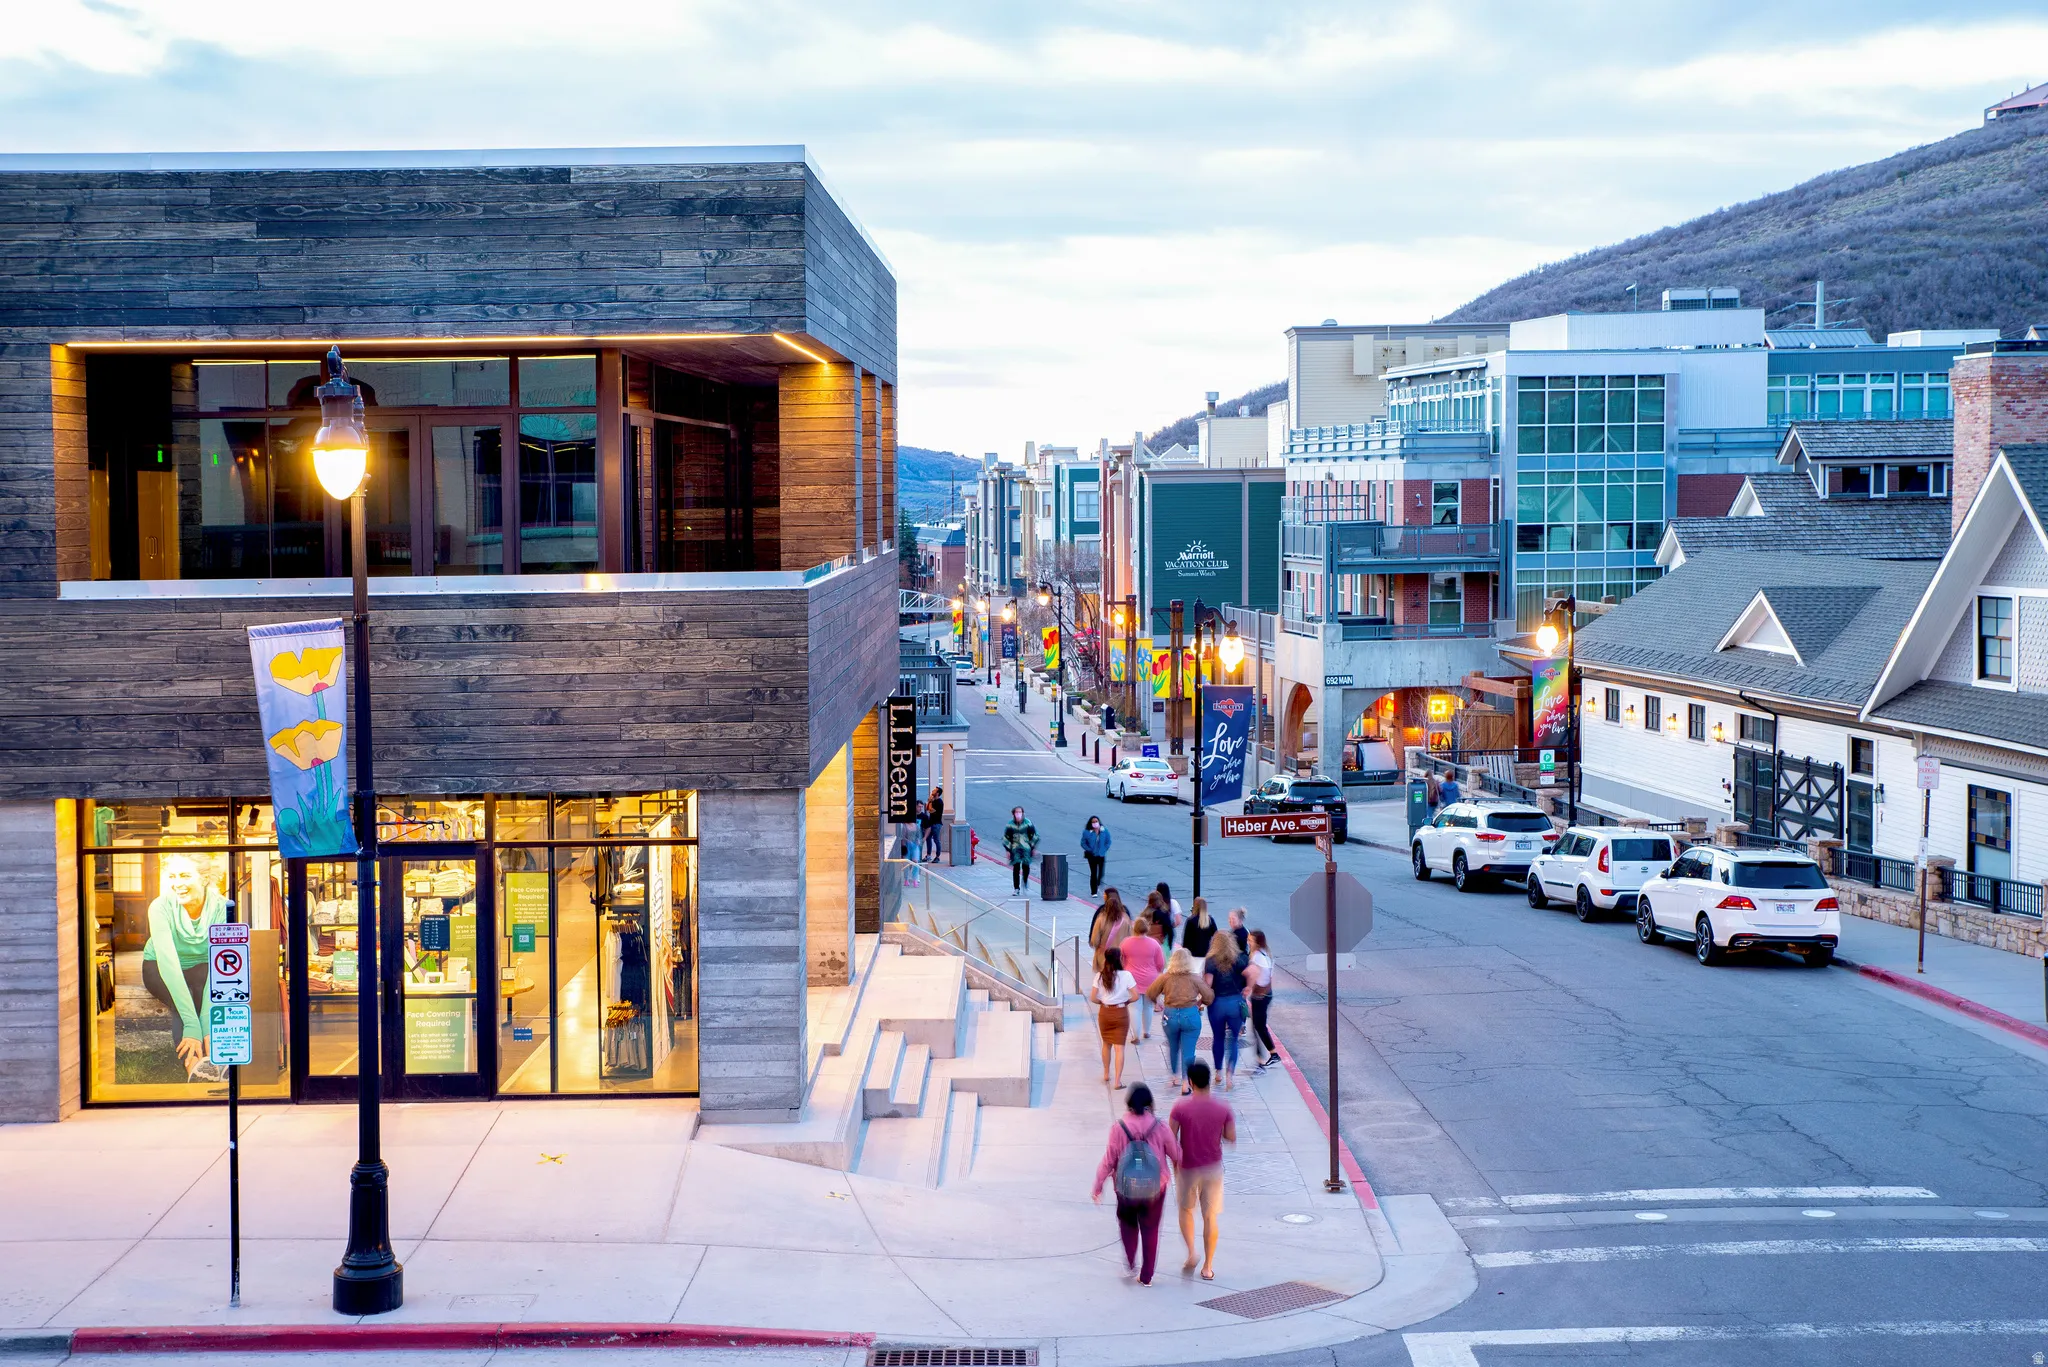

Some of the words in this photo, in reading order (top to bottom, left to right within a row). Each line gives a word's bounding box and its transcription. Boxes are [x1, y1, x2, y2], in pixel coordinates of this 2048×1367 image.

[1177, 551, 1214, 561] Marriott
[1326, 676, 1338, 685] 692
[1533, 685, 1564, 720] Love
[1546, 710, 1565, 722] where
[1538, 722, 1552, 737] you
[1552, 722, 1565, 733] live
[1201, 722, 1244, 769] Love
[890, 704, 912, 816] L.L.Bean
[1223, 757, 1242, 772] where
[1210, 773, 1226, 790] you
[1226, 770, 1241, 784] live
[1228, 820, 1267, 833] Heber
[1270, 818, 1300, 831] Ave.
[214, 1010, 222, 1021] 2
